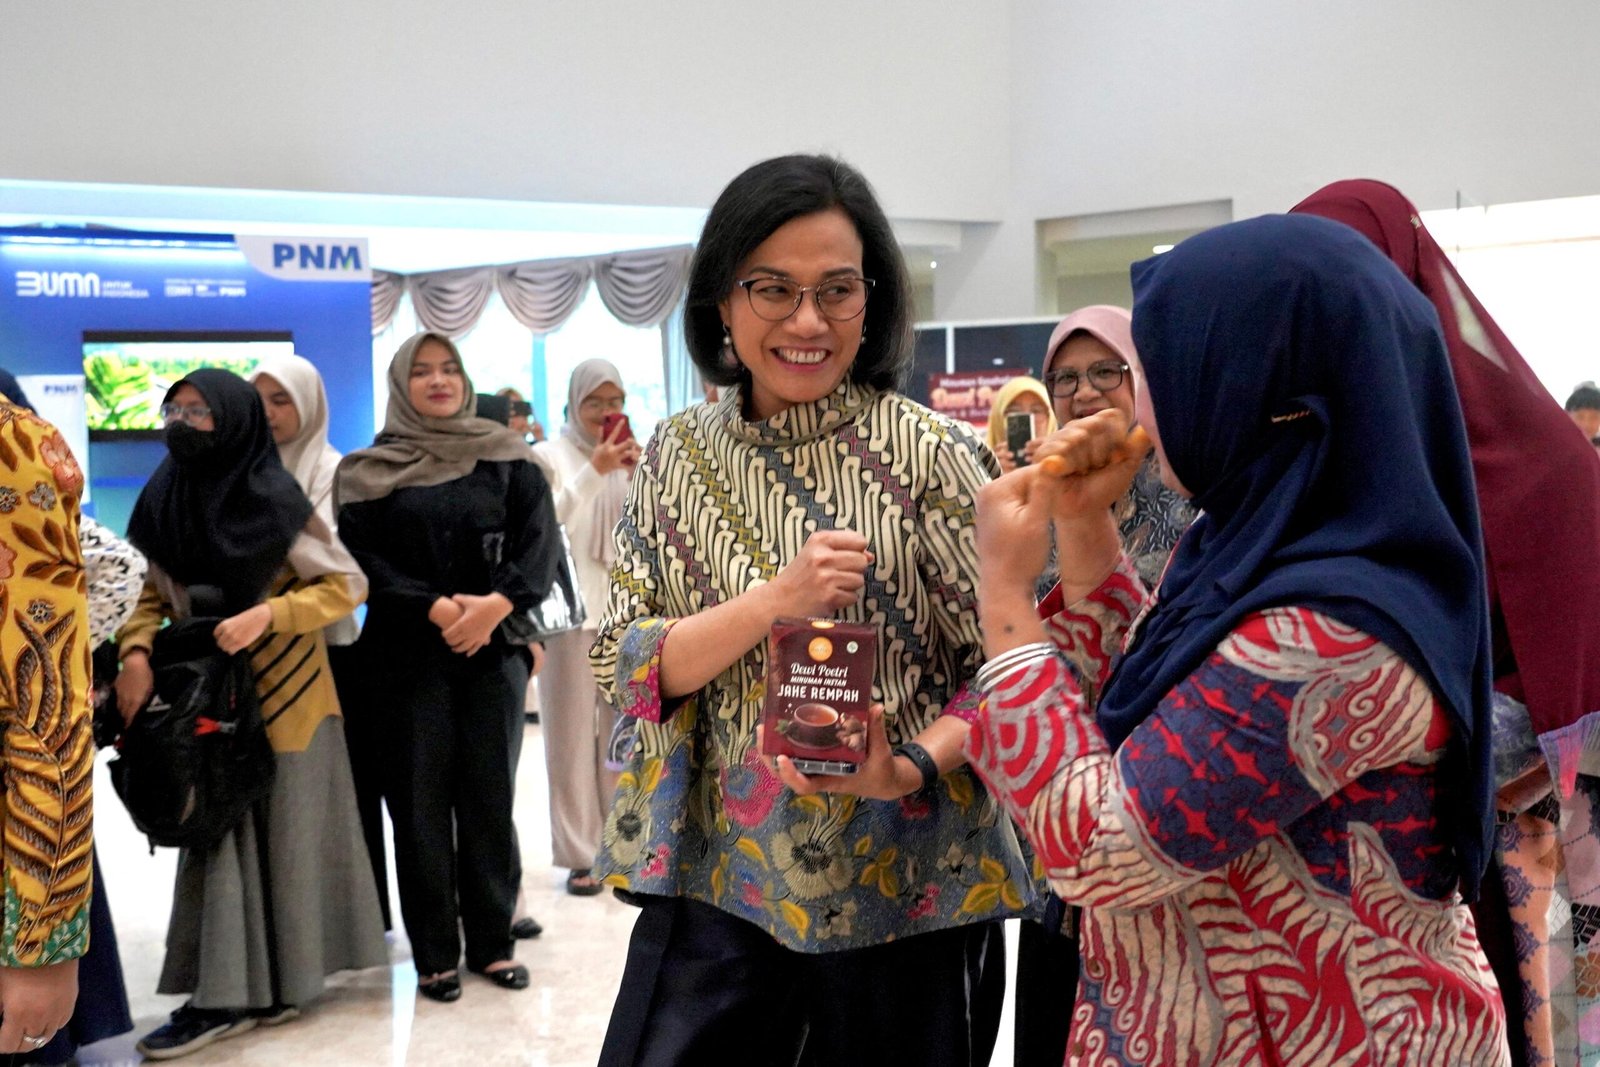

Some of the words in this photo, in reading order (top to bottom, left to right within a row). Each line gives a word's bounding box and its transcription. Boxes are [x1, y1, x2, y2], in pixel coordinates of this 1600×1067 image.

[273, 243, 362, 270] PNM
[16, 271, 99, 297] BUMN
[791, 662, 816, 675] Dewi
[817, 664, 848, 678] Poetri
[790, 676, 823, 684] MINUMAN
[823, 678, 847, 687] INSTAN
[777, 684, 807, 698] JAHE
[811, 686, 859, 703] REMPAH
